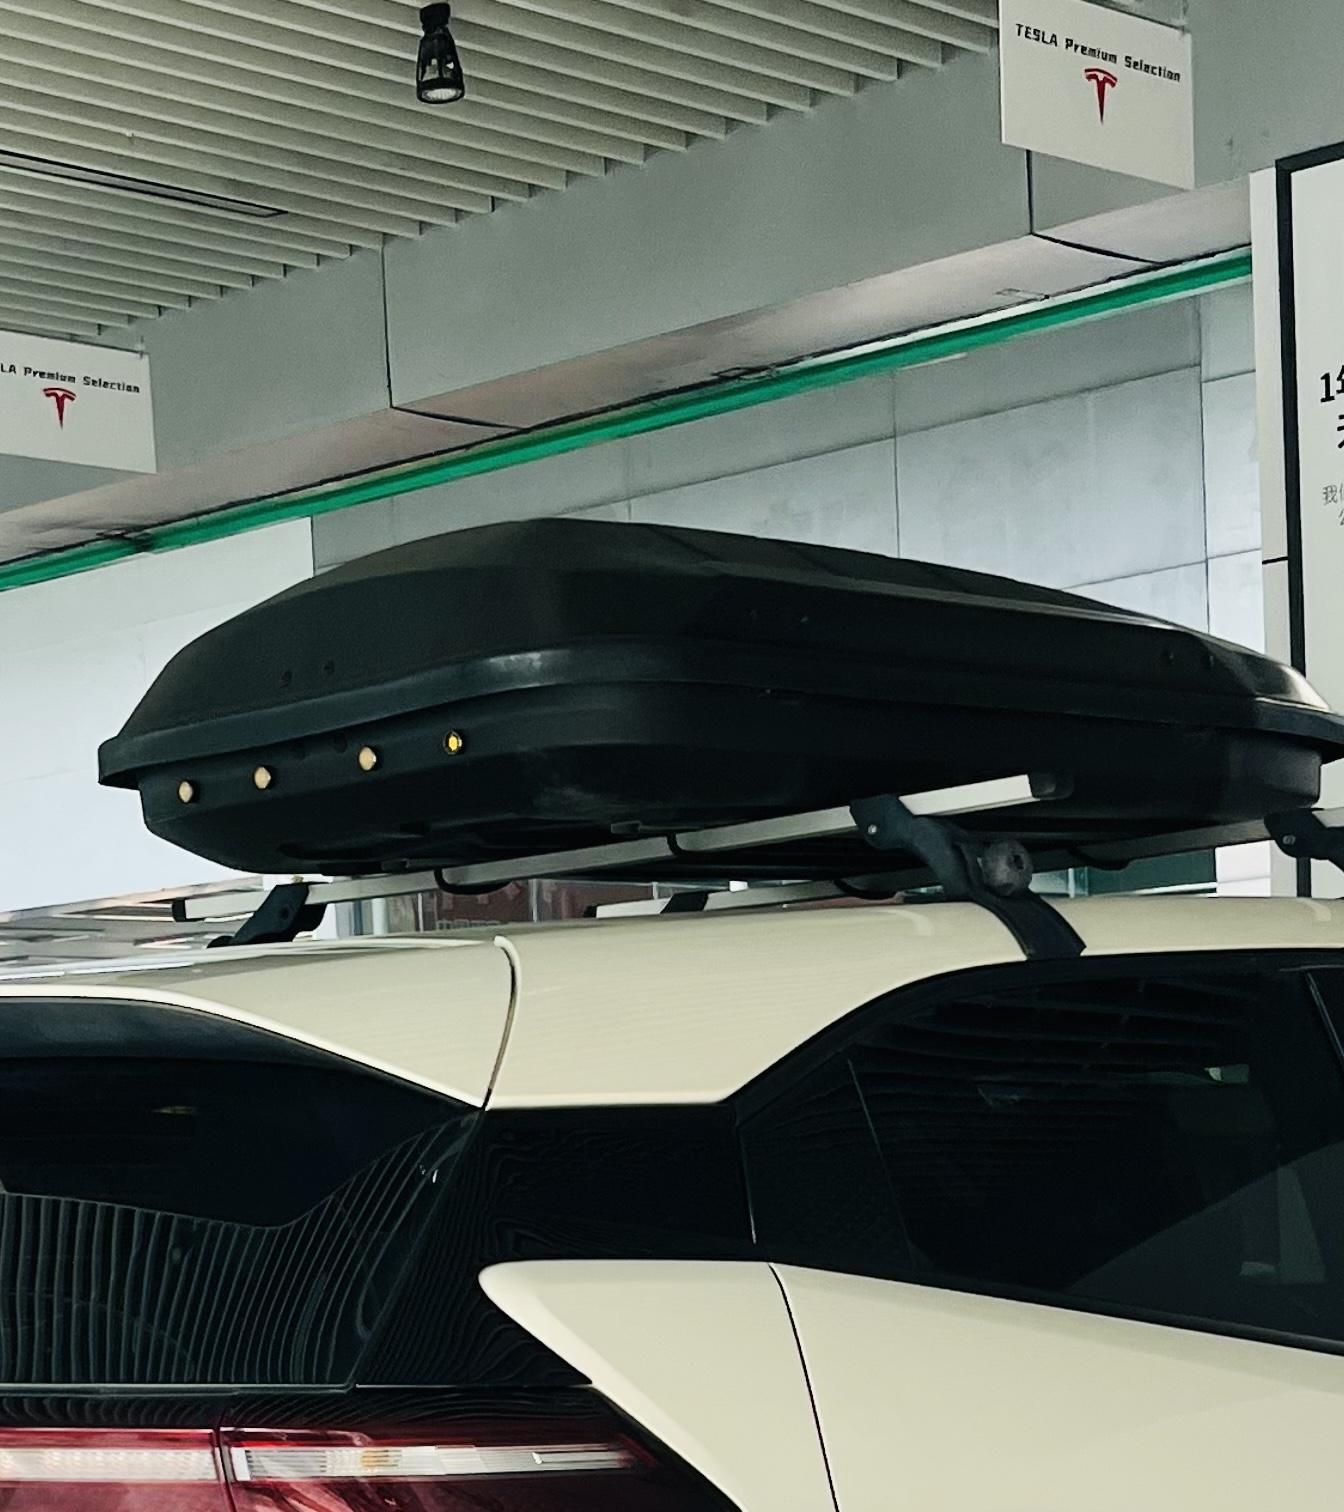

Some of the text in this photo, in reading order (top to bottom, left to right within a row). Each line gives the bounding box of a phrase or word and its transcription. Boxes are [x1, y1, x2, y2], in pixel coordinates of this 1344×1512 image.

[1015, 23, 1181, 82] TESLA Premium Selection
[24, 366, 76, 383] Premium
[83, 376, 140, 393] Selection
